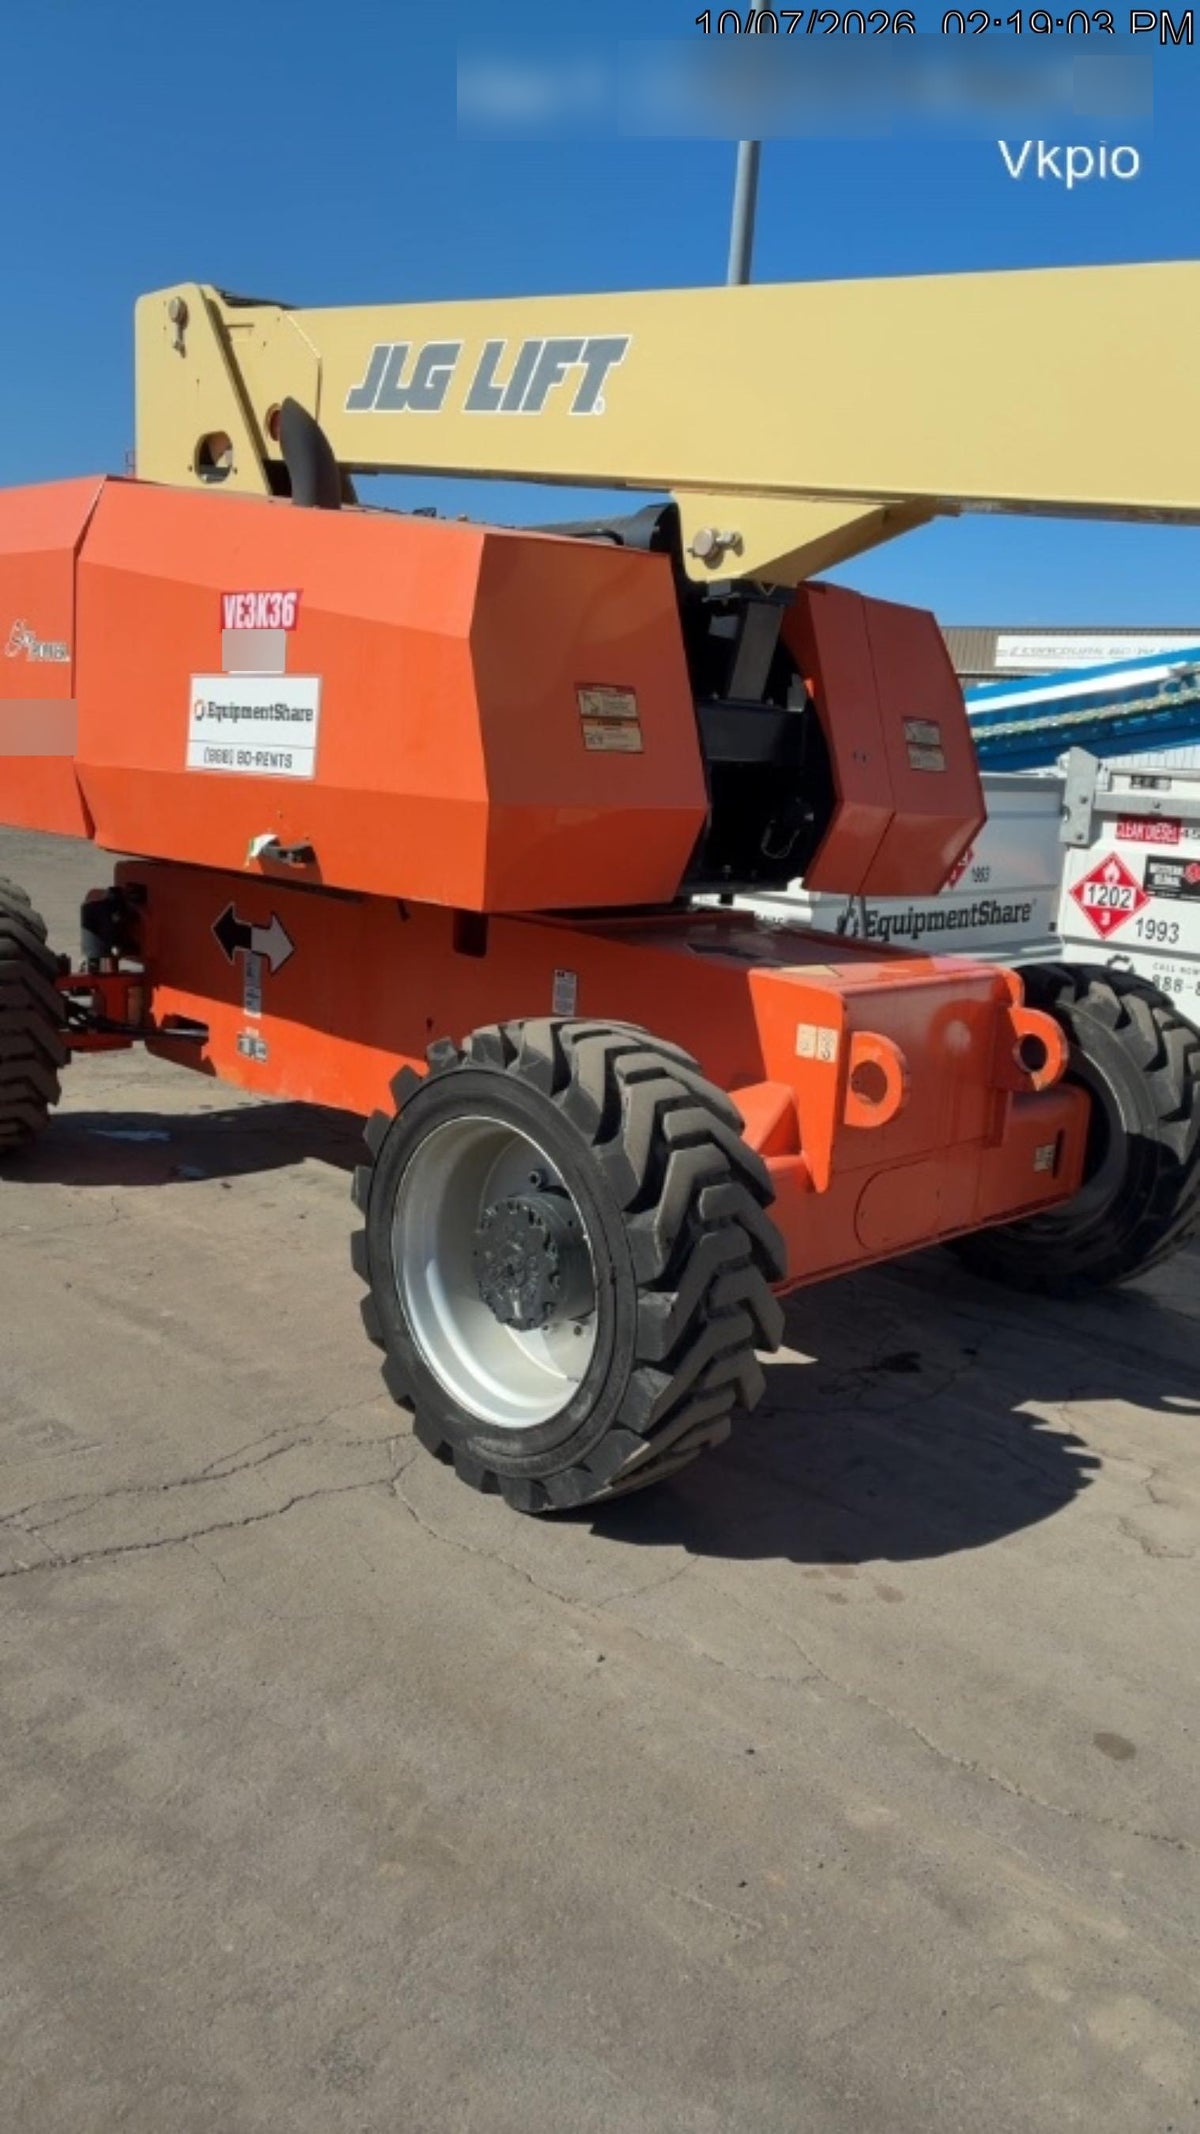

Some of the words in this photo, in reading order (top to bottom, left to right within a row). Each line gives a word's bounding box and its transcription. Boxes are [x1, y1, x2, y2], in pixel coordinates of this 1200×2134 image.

[345, 340, 464, 412] JLG
[461, 334, 632, 416] LIFT
[206, 700, 314, 724] EquipmentShare
[1088, 884, 1132, 909] 1202
[864, 899, 1033, 942] EquipmentShare
[1136, 917, 1180, 944] 1993
